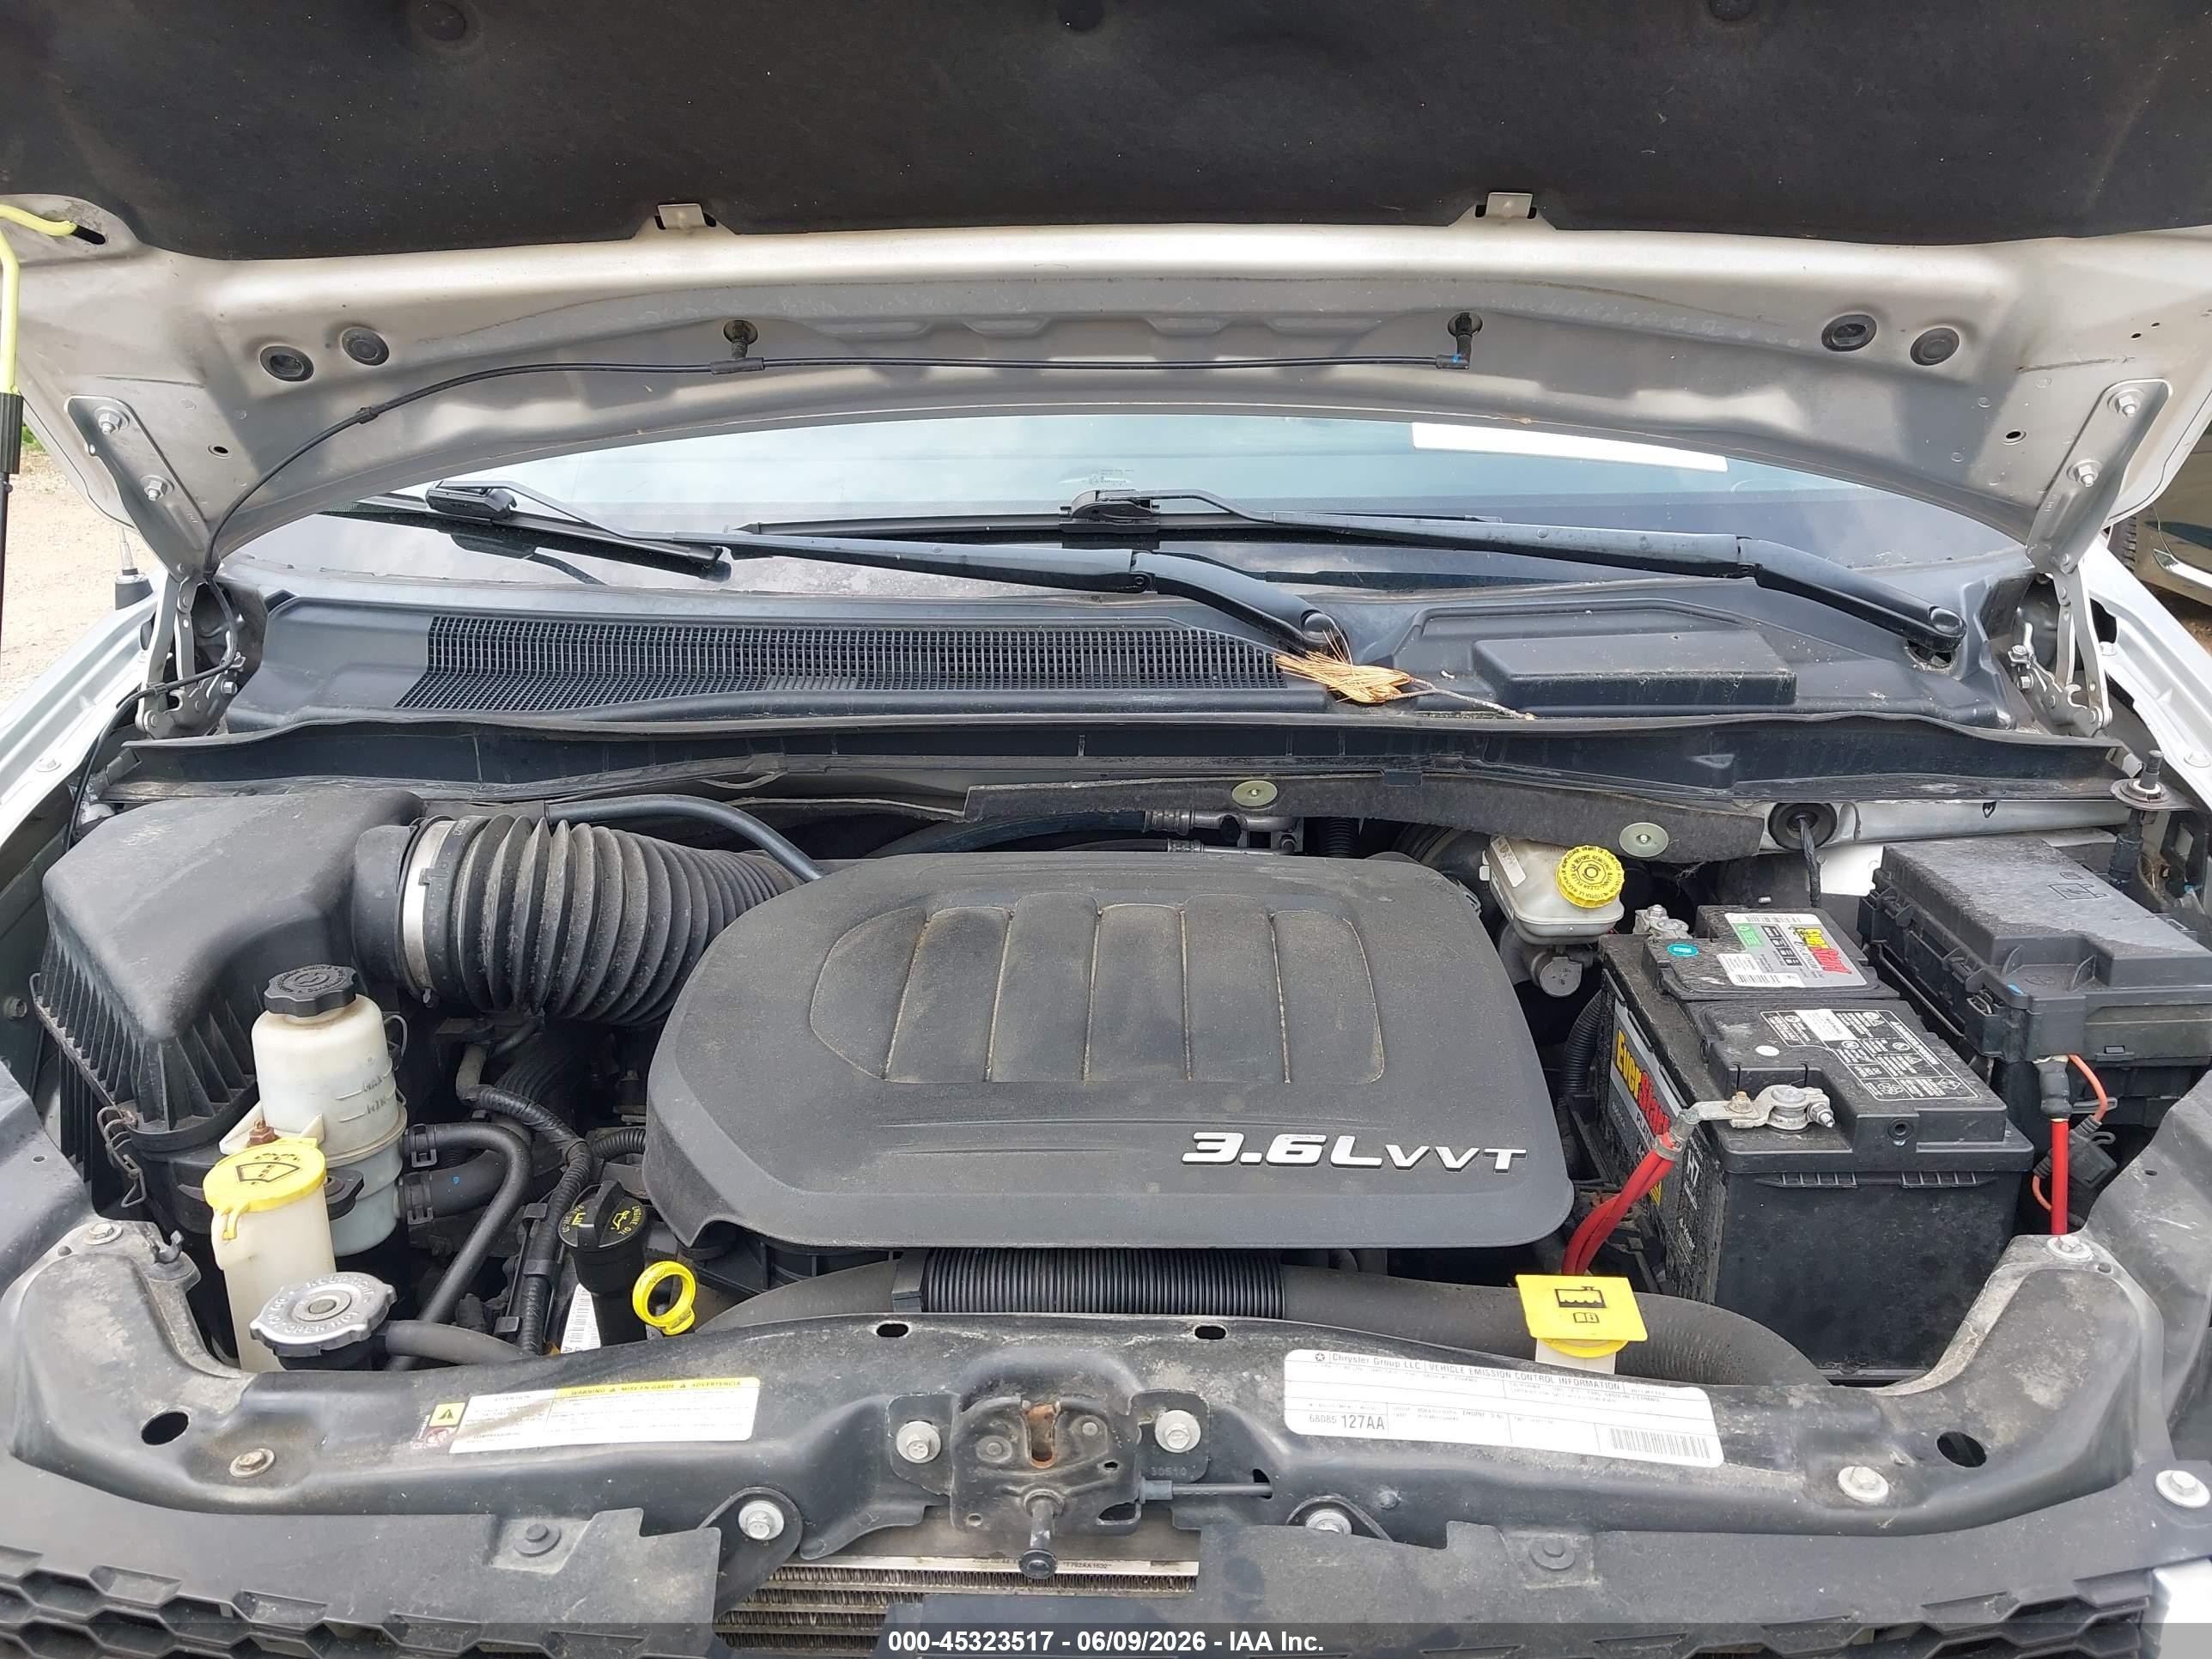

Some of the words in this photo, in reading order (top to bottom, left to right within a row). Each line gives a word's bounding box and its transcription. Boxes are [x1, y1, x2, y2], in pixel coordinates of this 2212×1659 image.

[1182, 1131, 1383, 1169] 3.6L
[1385, 1143, 1528, 1175] VVT
[629, 1205, 642, 1225] ENGINE
[617, 1226, 632, 1236] OIL
[1332, 1352, 1370, 1364] Chrysler
[1374, 1357, 1401, 1369] Group
[1404, 1361, 1421, 1370] LLC
[1429, 1362, 1465, 1375] VEHICLE
[1469, 1368, 1511, 1379] EMISSION
[1516, 1372, 1555, 1383] CONTROL
[1559, 1376, 1620, 1391] INFORMATION
[1341, 1414, 1385, 1430] 127AA
